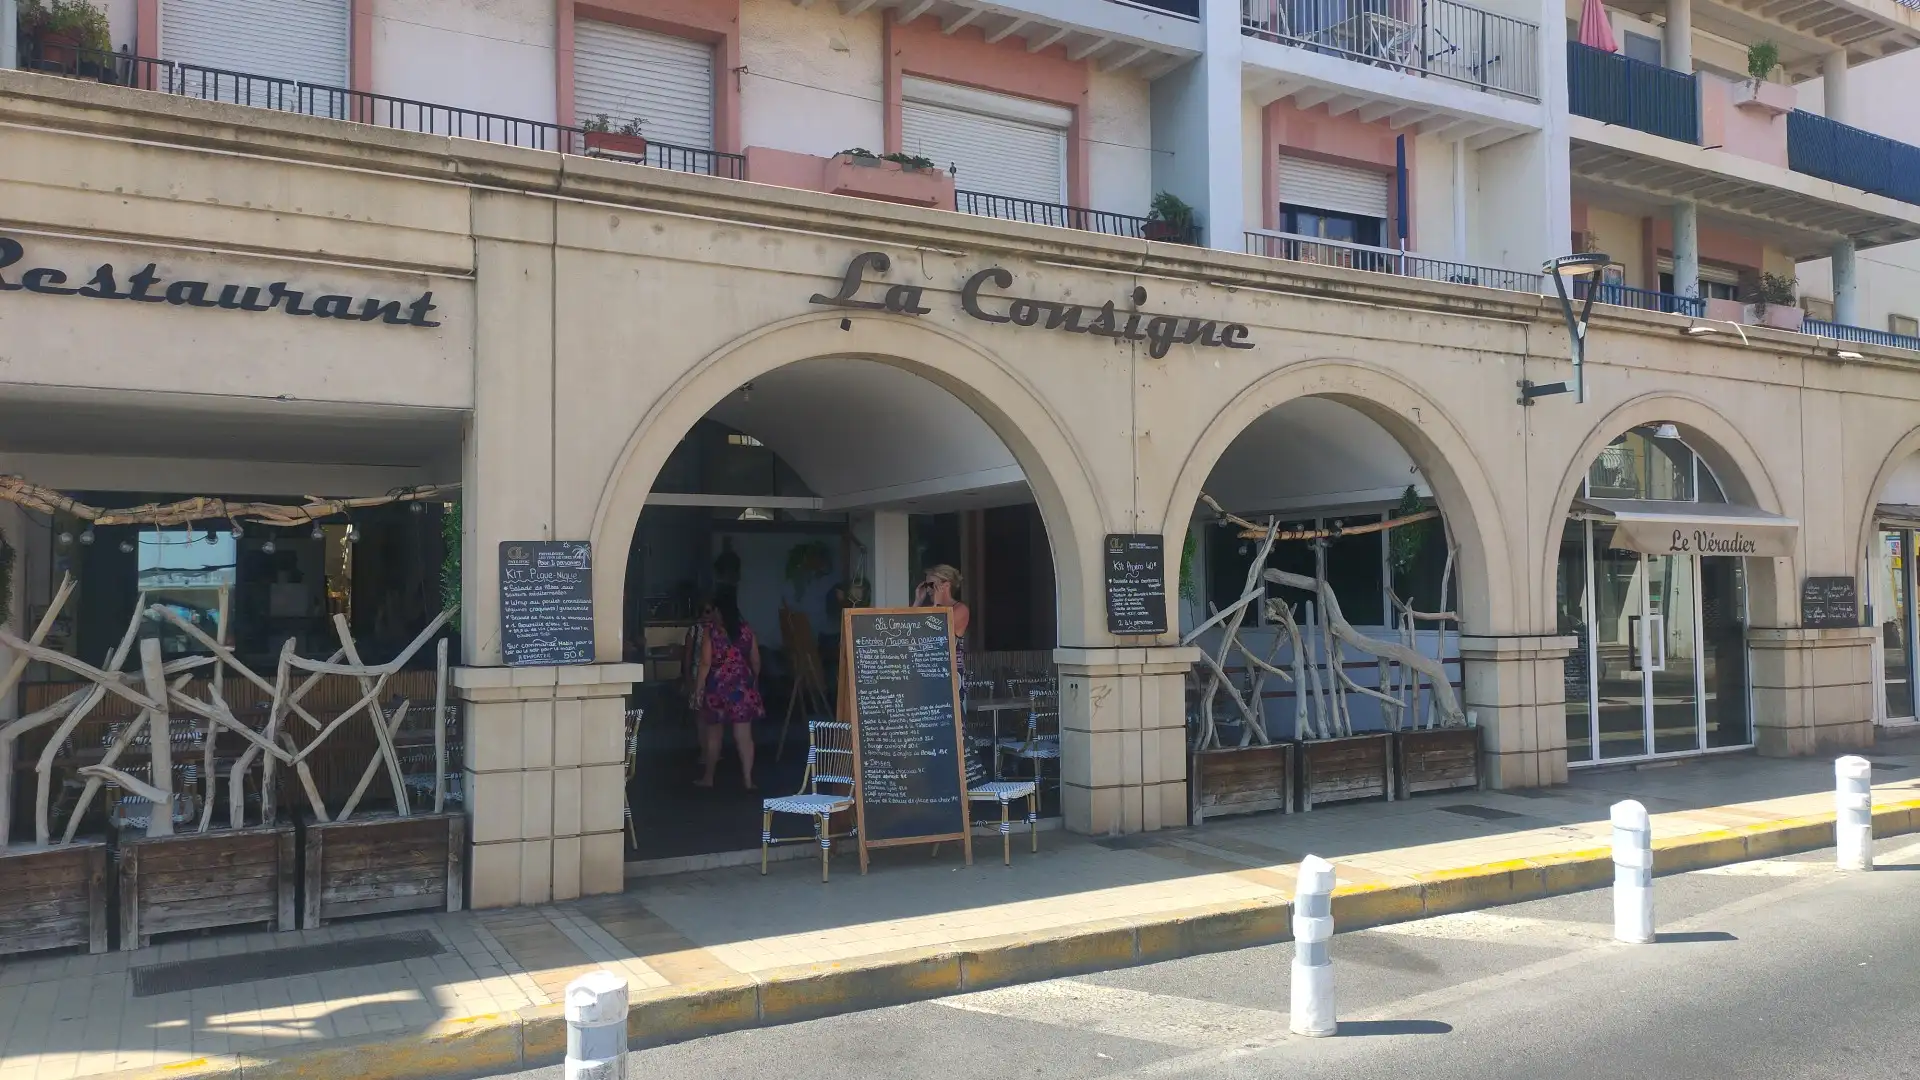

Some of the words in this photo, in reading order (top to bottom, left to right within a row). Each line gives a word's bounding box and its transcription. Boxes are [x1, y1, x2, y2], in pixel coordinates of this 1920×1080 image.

[809, 251, 931, 315] La
[961, 268, 1256, 360] Consigne
[1669, 529, 1690, 552] Le
[1693, 530, 1756, 553] Véradier
[1113, 561, 1124, 570] Kit
[530, 568, 577, 583] Pique-Nique
[889, 619, 921, 636] Consigne
[563, 651, 577, 659] 50
